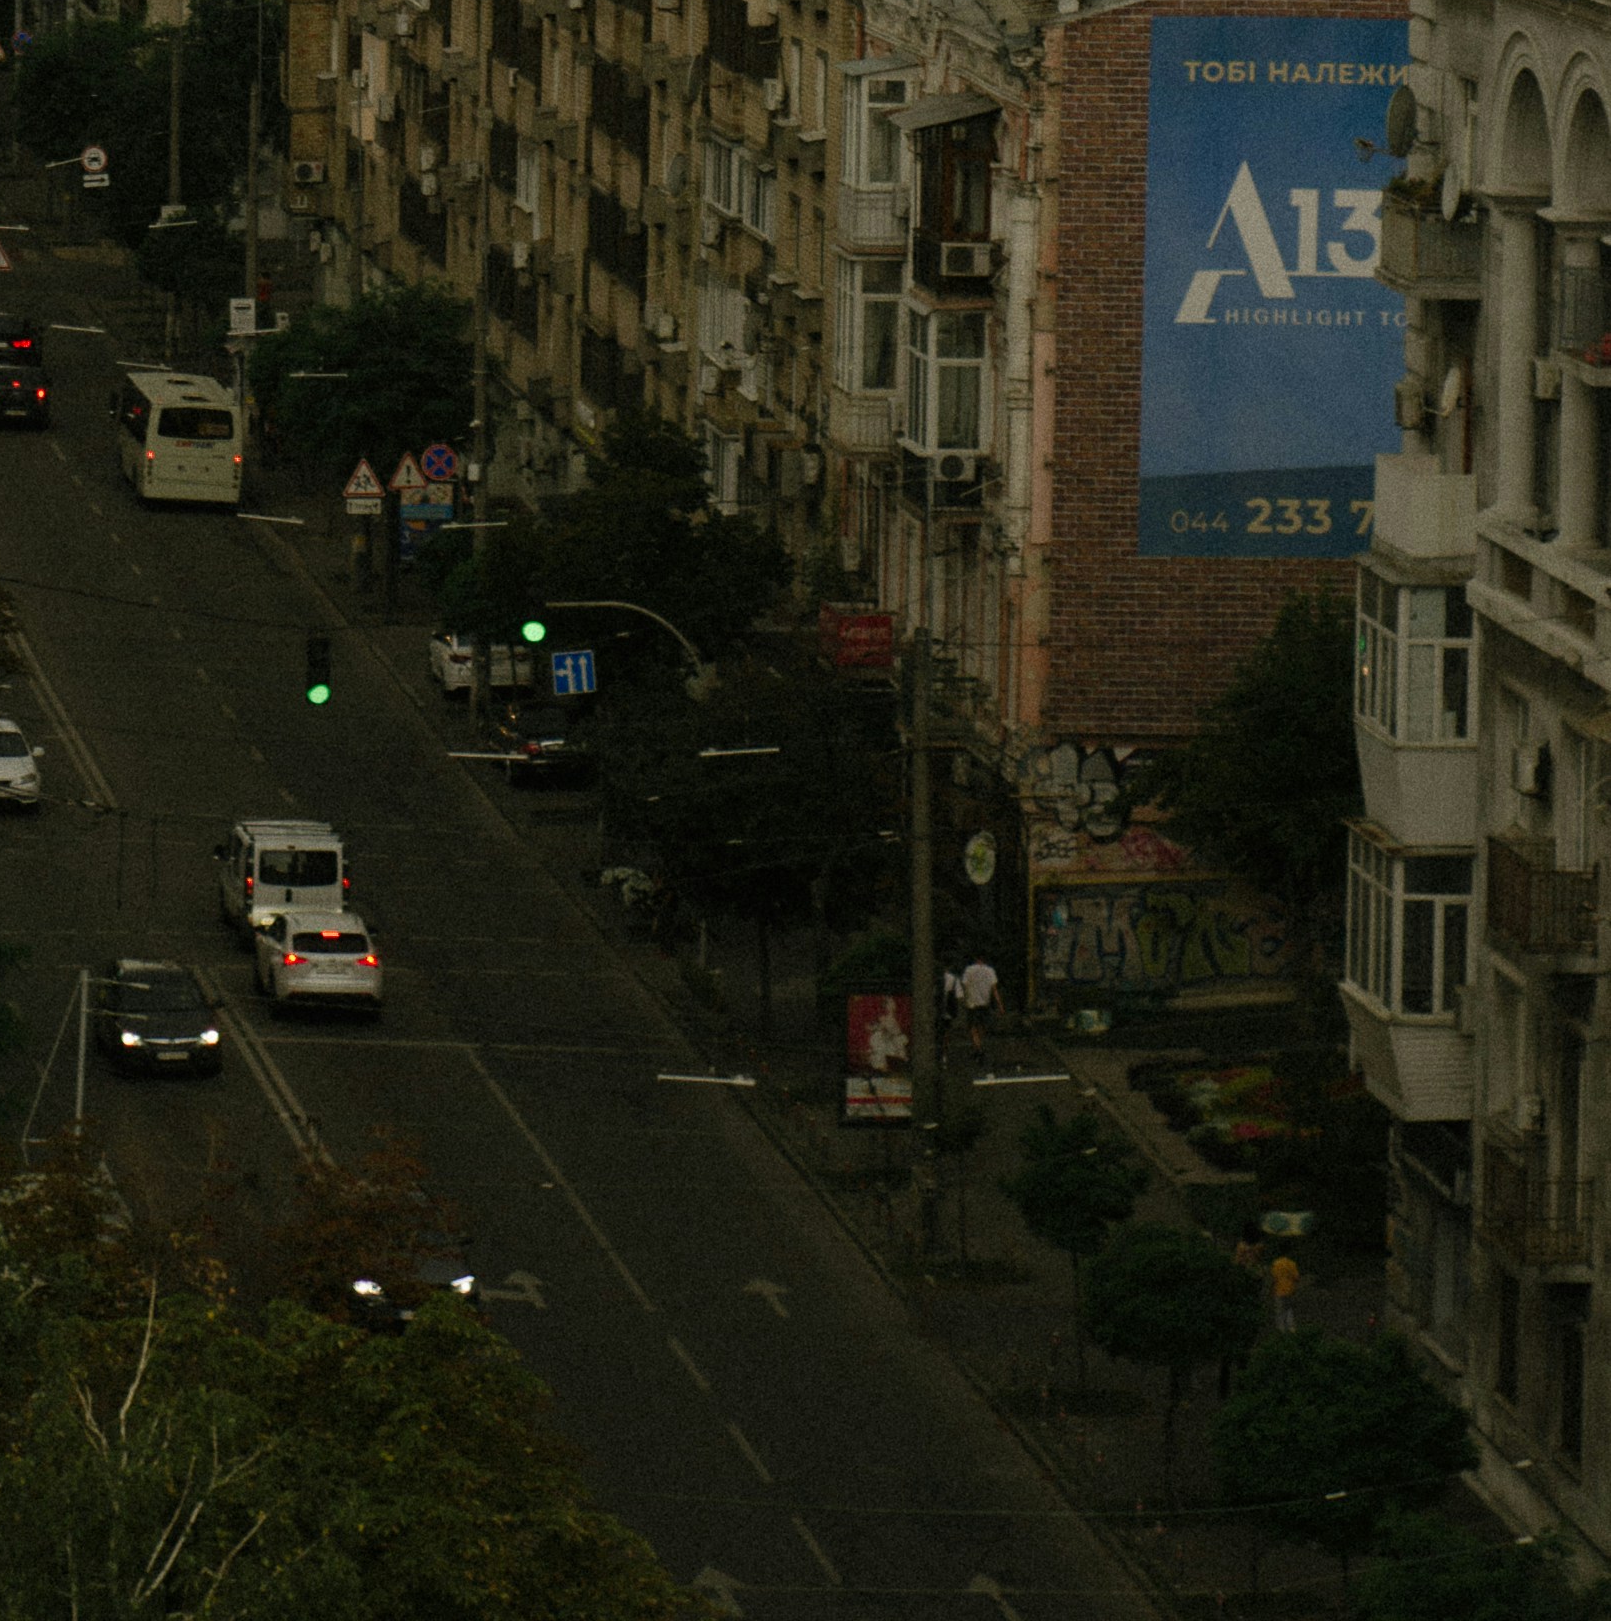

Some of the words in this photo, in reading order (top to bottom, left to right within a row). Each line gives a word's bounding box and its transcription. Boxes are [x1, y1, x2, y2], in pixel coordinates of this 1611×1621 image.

[1184, 60, 1257, 84] ТОБІ
[1225, 308, 1366, 326] HIGHLIGHT
[1170, 509, 1229, 533] 044
[1245, 497, 1333, 535] 233
